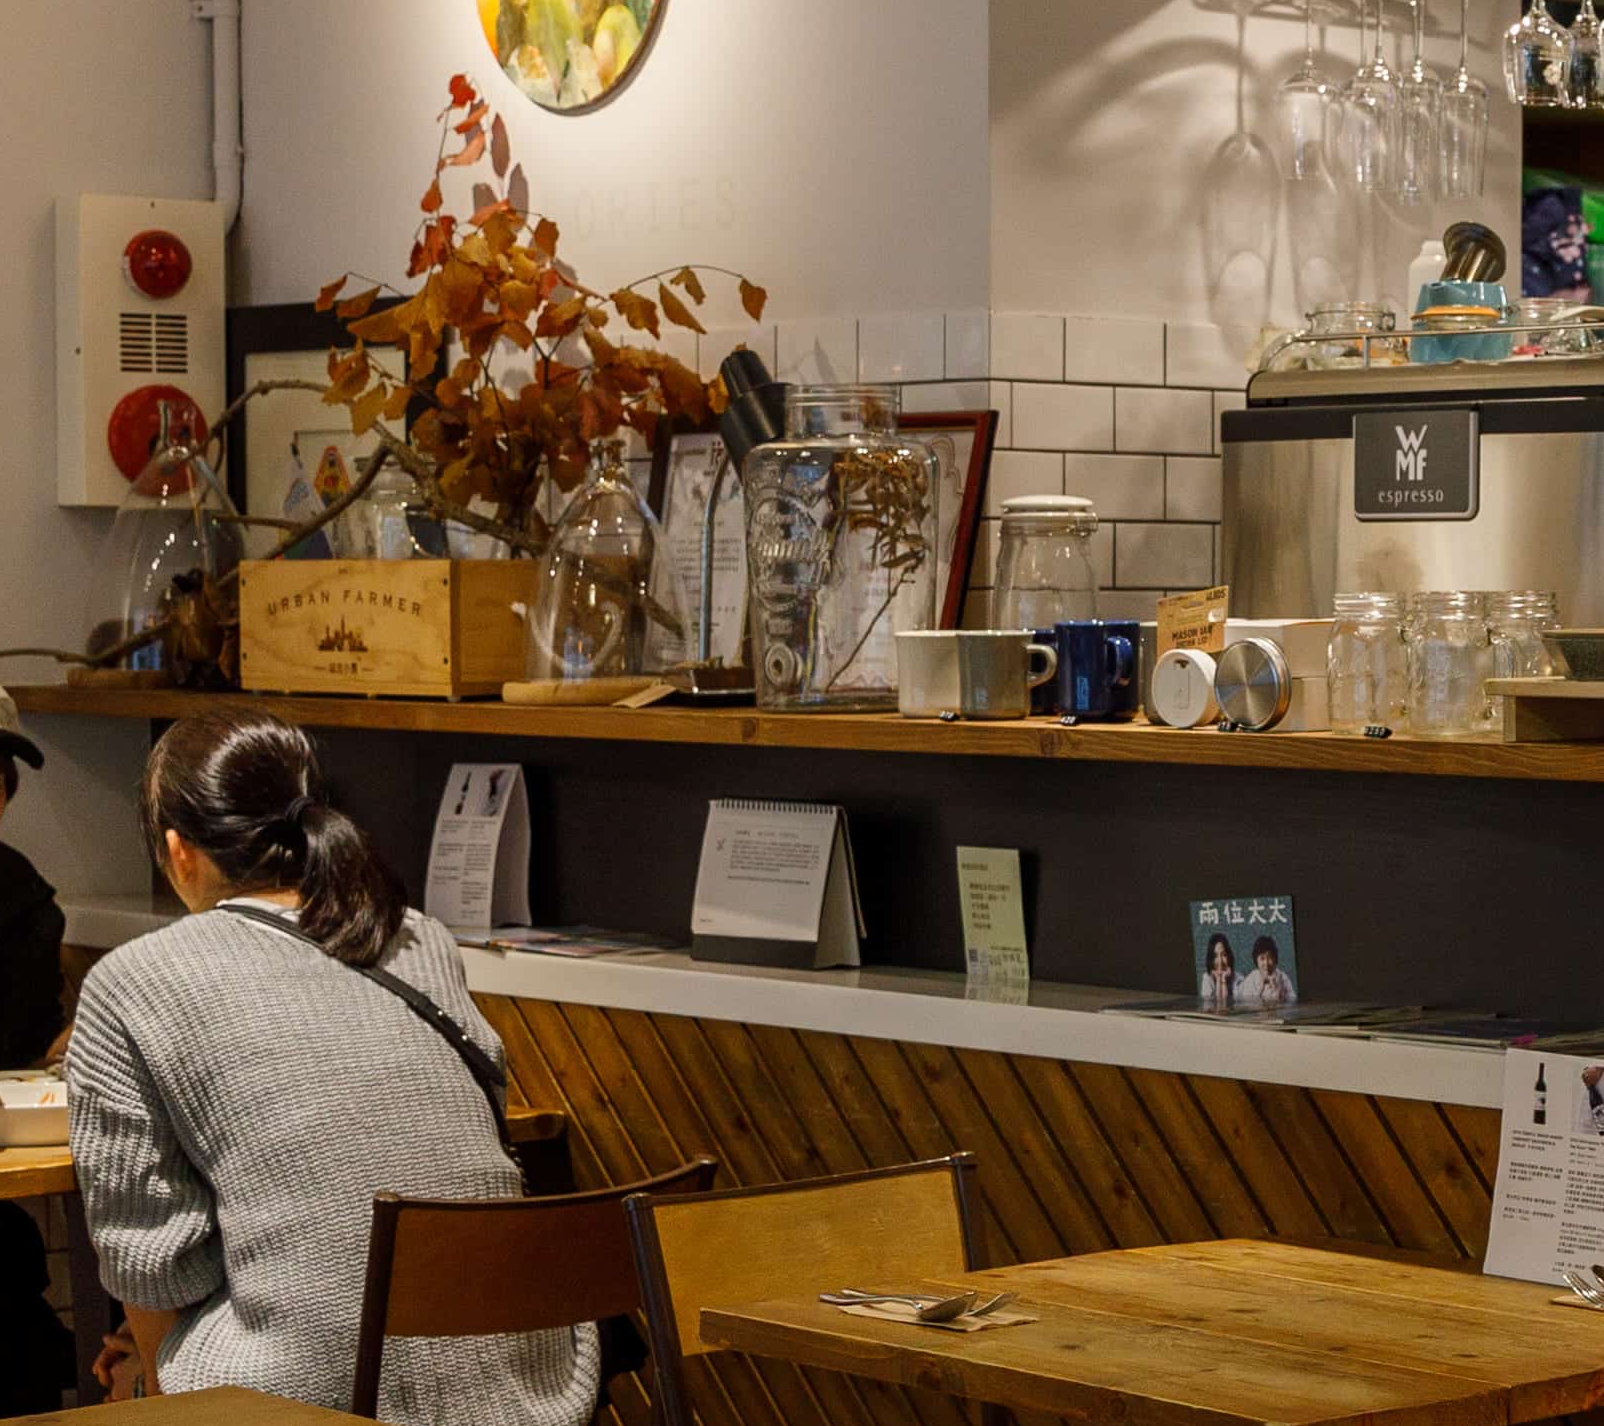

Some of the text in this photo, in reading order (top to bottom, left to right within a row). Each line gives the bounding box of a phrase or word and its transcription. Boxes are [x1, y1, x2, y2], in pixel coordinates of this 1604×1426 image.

[1378, 489, 1444, 507] espresso
[268, 589, 422, 616] URBAN FARMER
